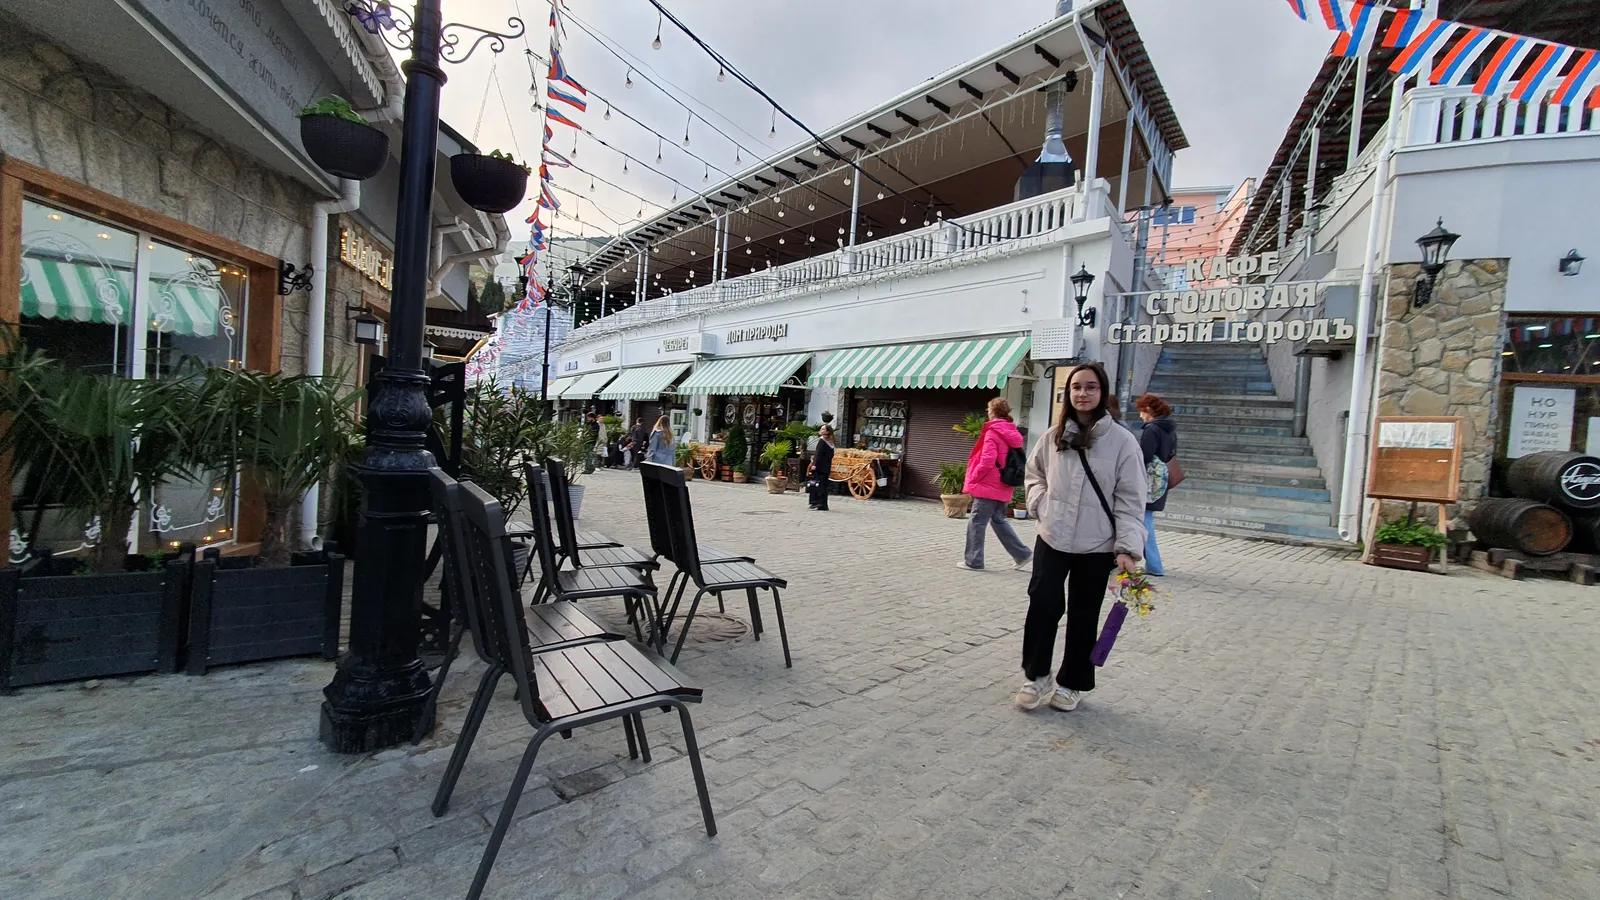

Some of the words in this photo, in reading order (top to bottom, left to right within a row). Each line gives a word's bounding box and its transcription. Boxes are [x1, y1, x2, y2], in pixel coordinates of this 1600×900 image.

[1185, 251, 1280, 282] КАФЕ
[1146, 282, 1319, 316] СТОЛОВАЯ
[725, 330, 744, 344] ДОМ
[744, 323, 788, 342] ПРИРОДЫ
[1107, 318, 1215, 345] Старый
